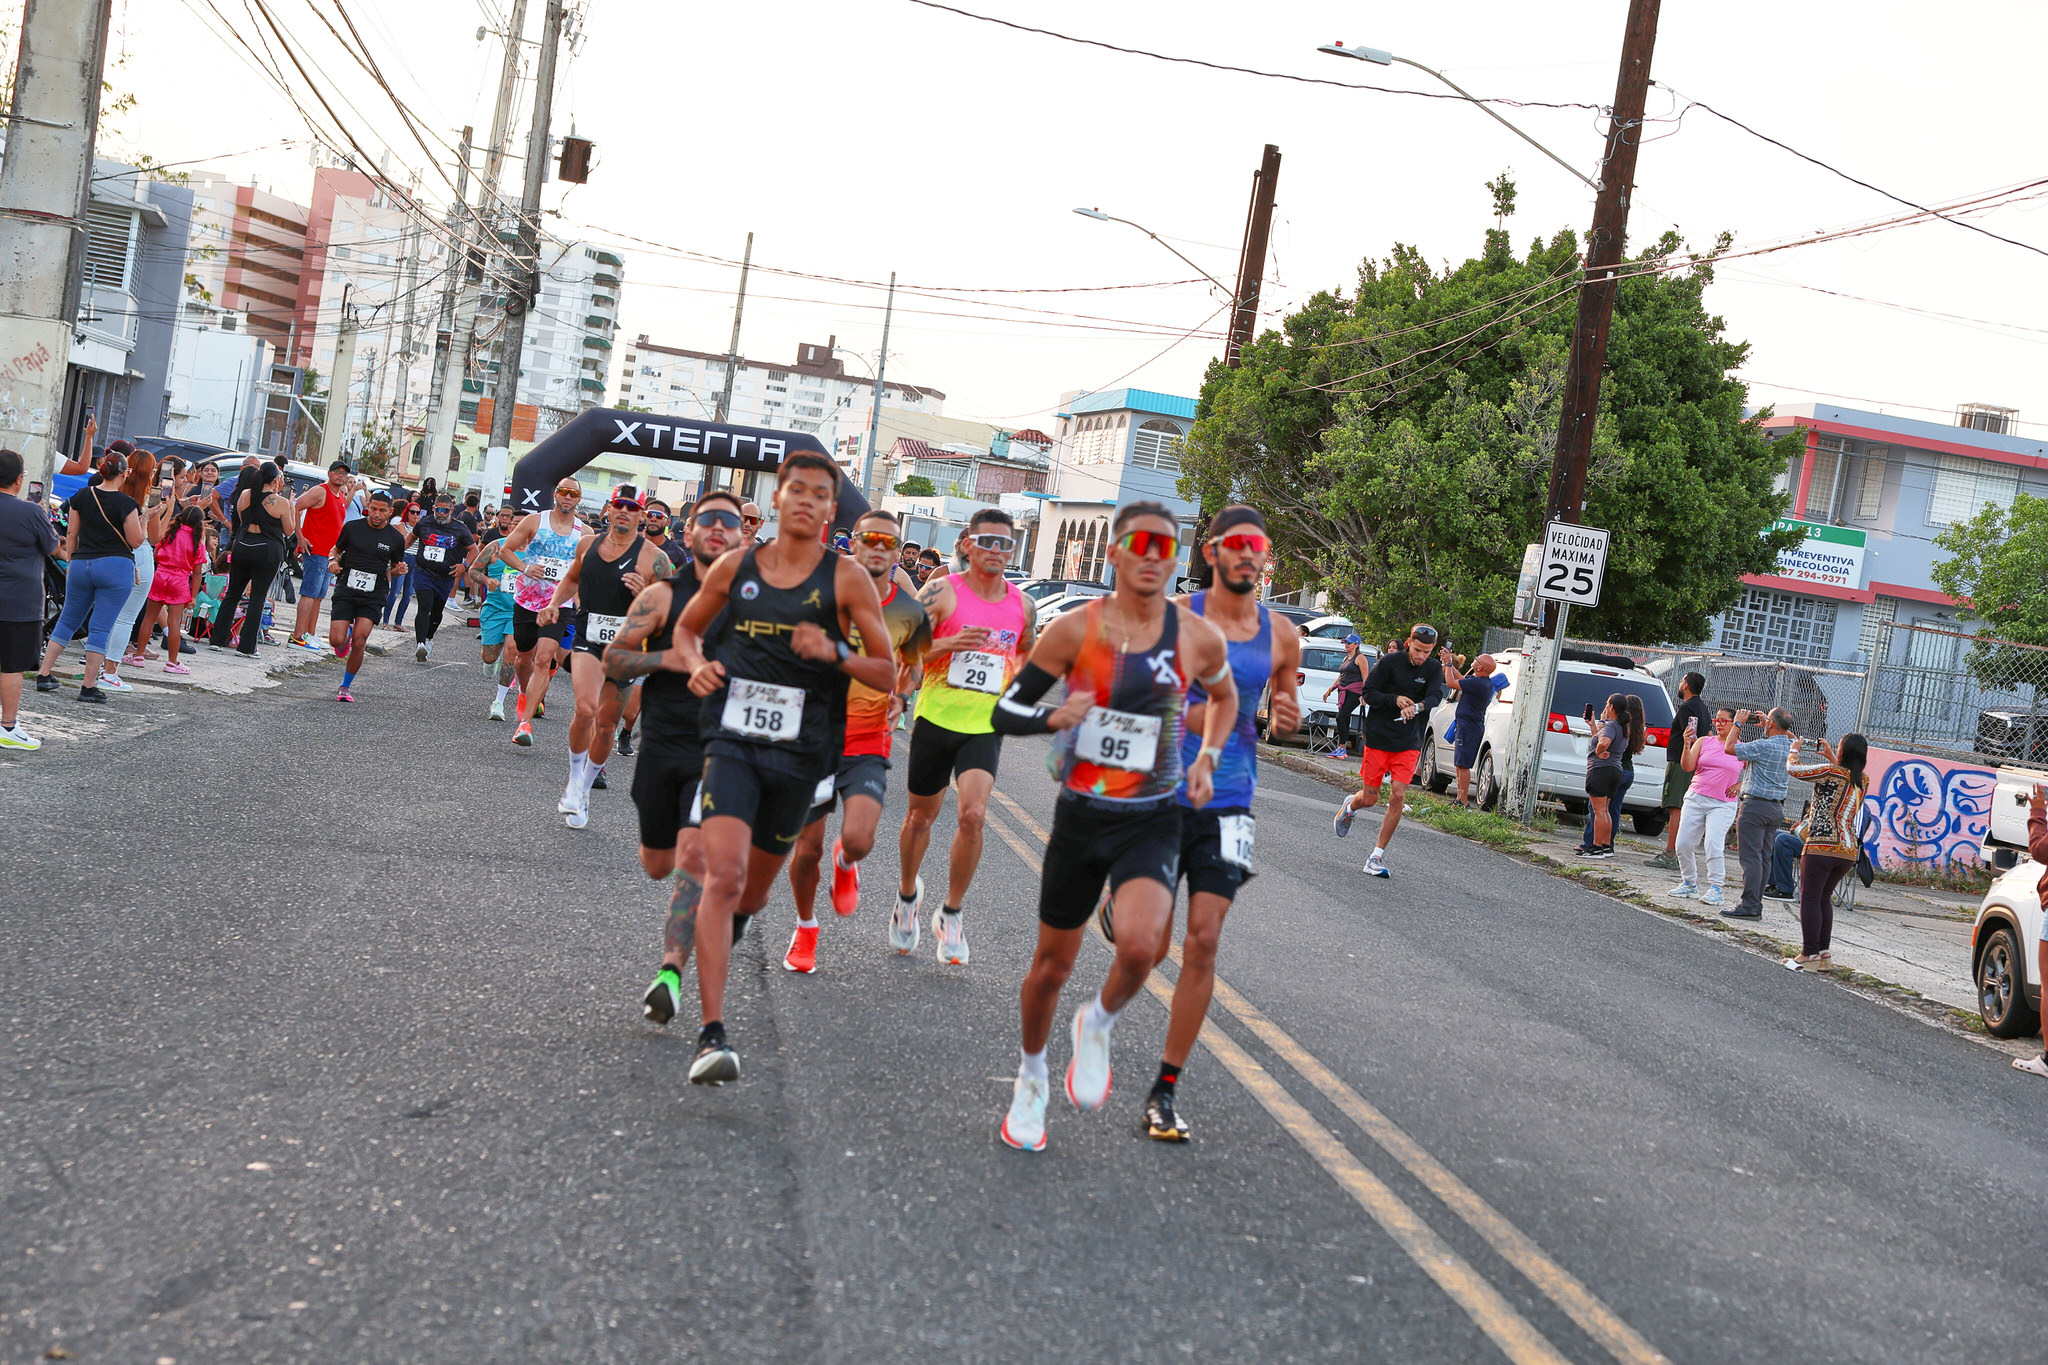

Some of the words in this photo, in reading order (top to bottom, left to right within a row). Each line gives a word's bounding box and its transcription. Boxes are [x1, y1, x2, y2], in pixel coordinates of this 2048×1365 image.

[611, 419, 786, 463] XTERRA
[521, 488, 541, 513] X
[1551, 531, 1603, 550] VELOCIDAD
[1799, 525, 1822, 538] 13
[430, 552, 438, 560] 12
[1551, 547, 1595, 565] MAXIMA
[1791, 550, 1855, 567] PREVENTIVA
[544, 566, 558, 578] 85
[1777, 557, 1850, 576] GINECOLOGIA
[355, 579, 367, 589] 72
[1544, 563, 1594, 595] 25
[1797, 570, 1847, 584] 294-9371
[508, 582, 515, 591] 5
[600, 628, 616, 642] 68
[965, 668, 987, 686] 29
[743, 705, 783, 732] 158
[1100, 736, 1131, 761] 95
